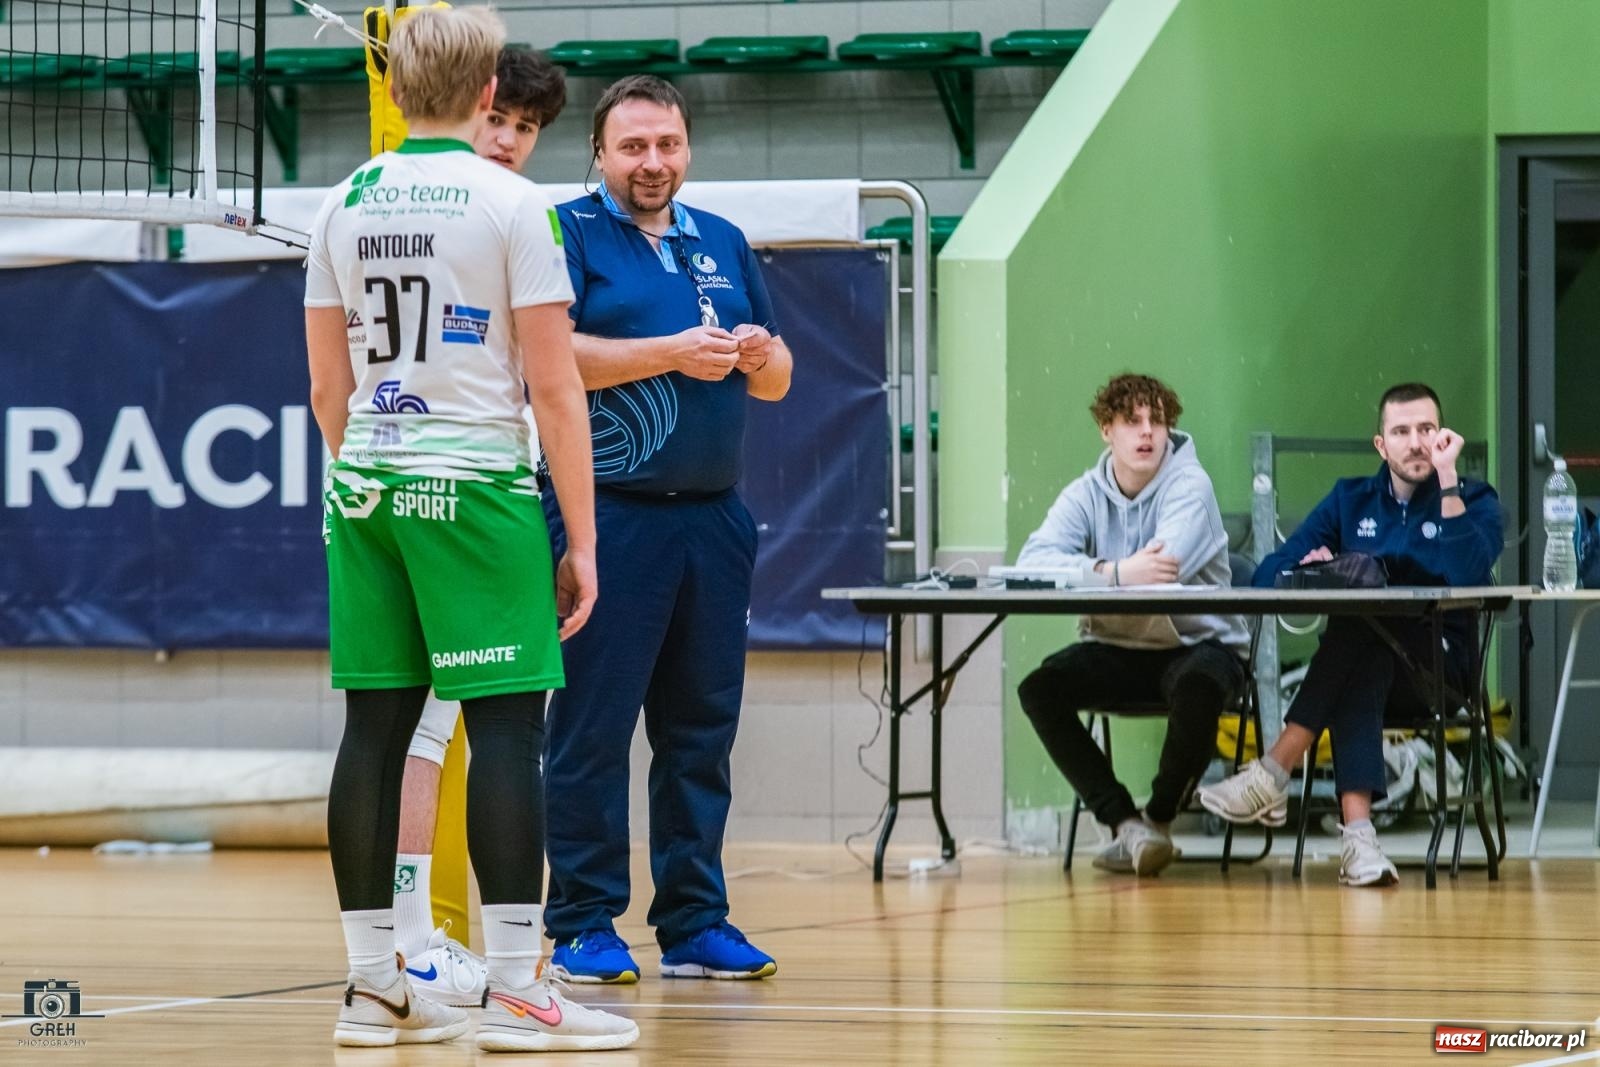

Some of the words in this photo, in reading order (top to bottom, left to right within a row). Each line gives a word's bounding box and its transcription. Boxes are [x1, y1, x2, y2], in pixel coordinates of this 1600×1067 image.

[362, 184, 469, 204] eco-team
[224, 212, 247, 228] netex
[358, 233, 435, 260] ANTOLAK
[364, 275, 430, 364] 37
[5, 404, 327, 509] RACI
[393, 491, 459, 522] SPORT
